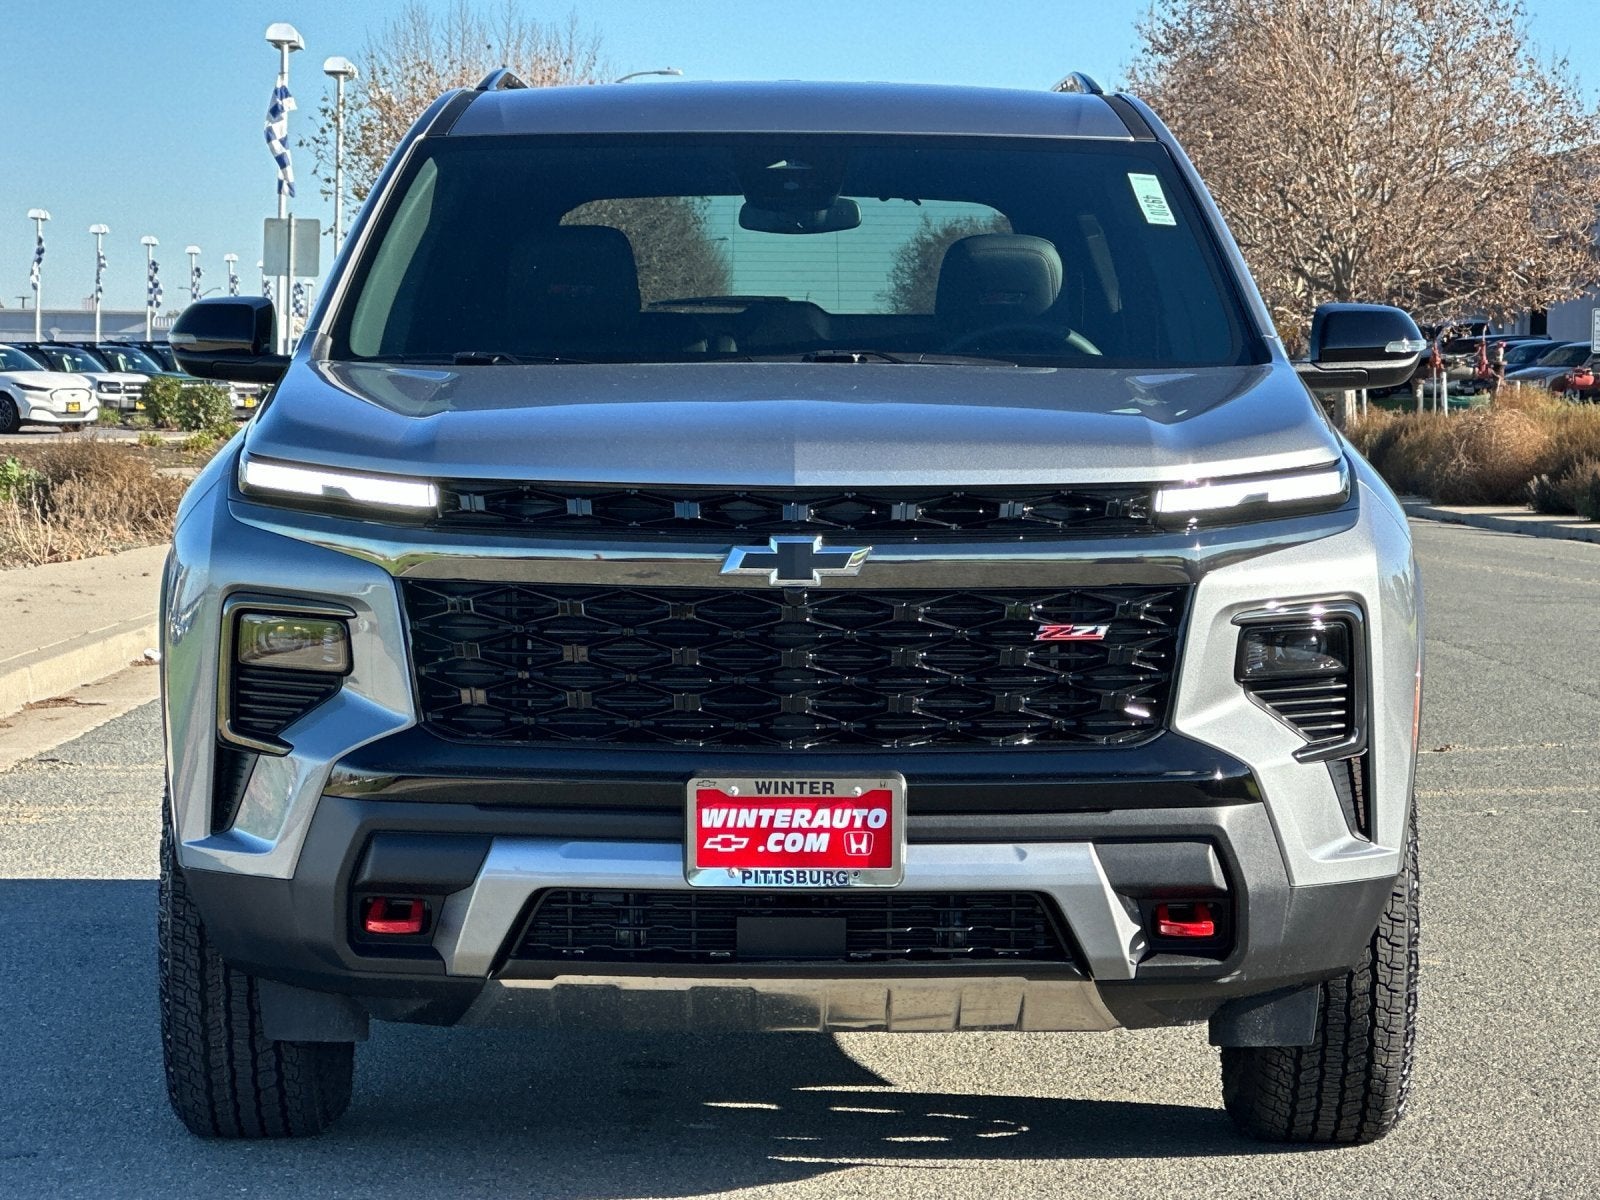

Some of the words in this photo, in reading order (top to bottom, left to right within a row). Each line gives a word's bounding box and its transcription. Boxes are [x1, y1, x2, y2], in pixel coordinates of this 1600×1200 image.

[1034, 624, 1110, 641] Z71
[754, 780, 835, 796] WINTER
[701, 807, 888, 829] WINTERAUTO
[757, 832, 831, 853] .COM
[741, 870, 849, 886] PITTSBURG
